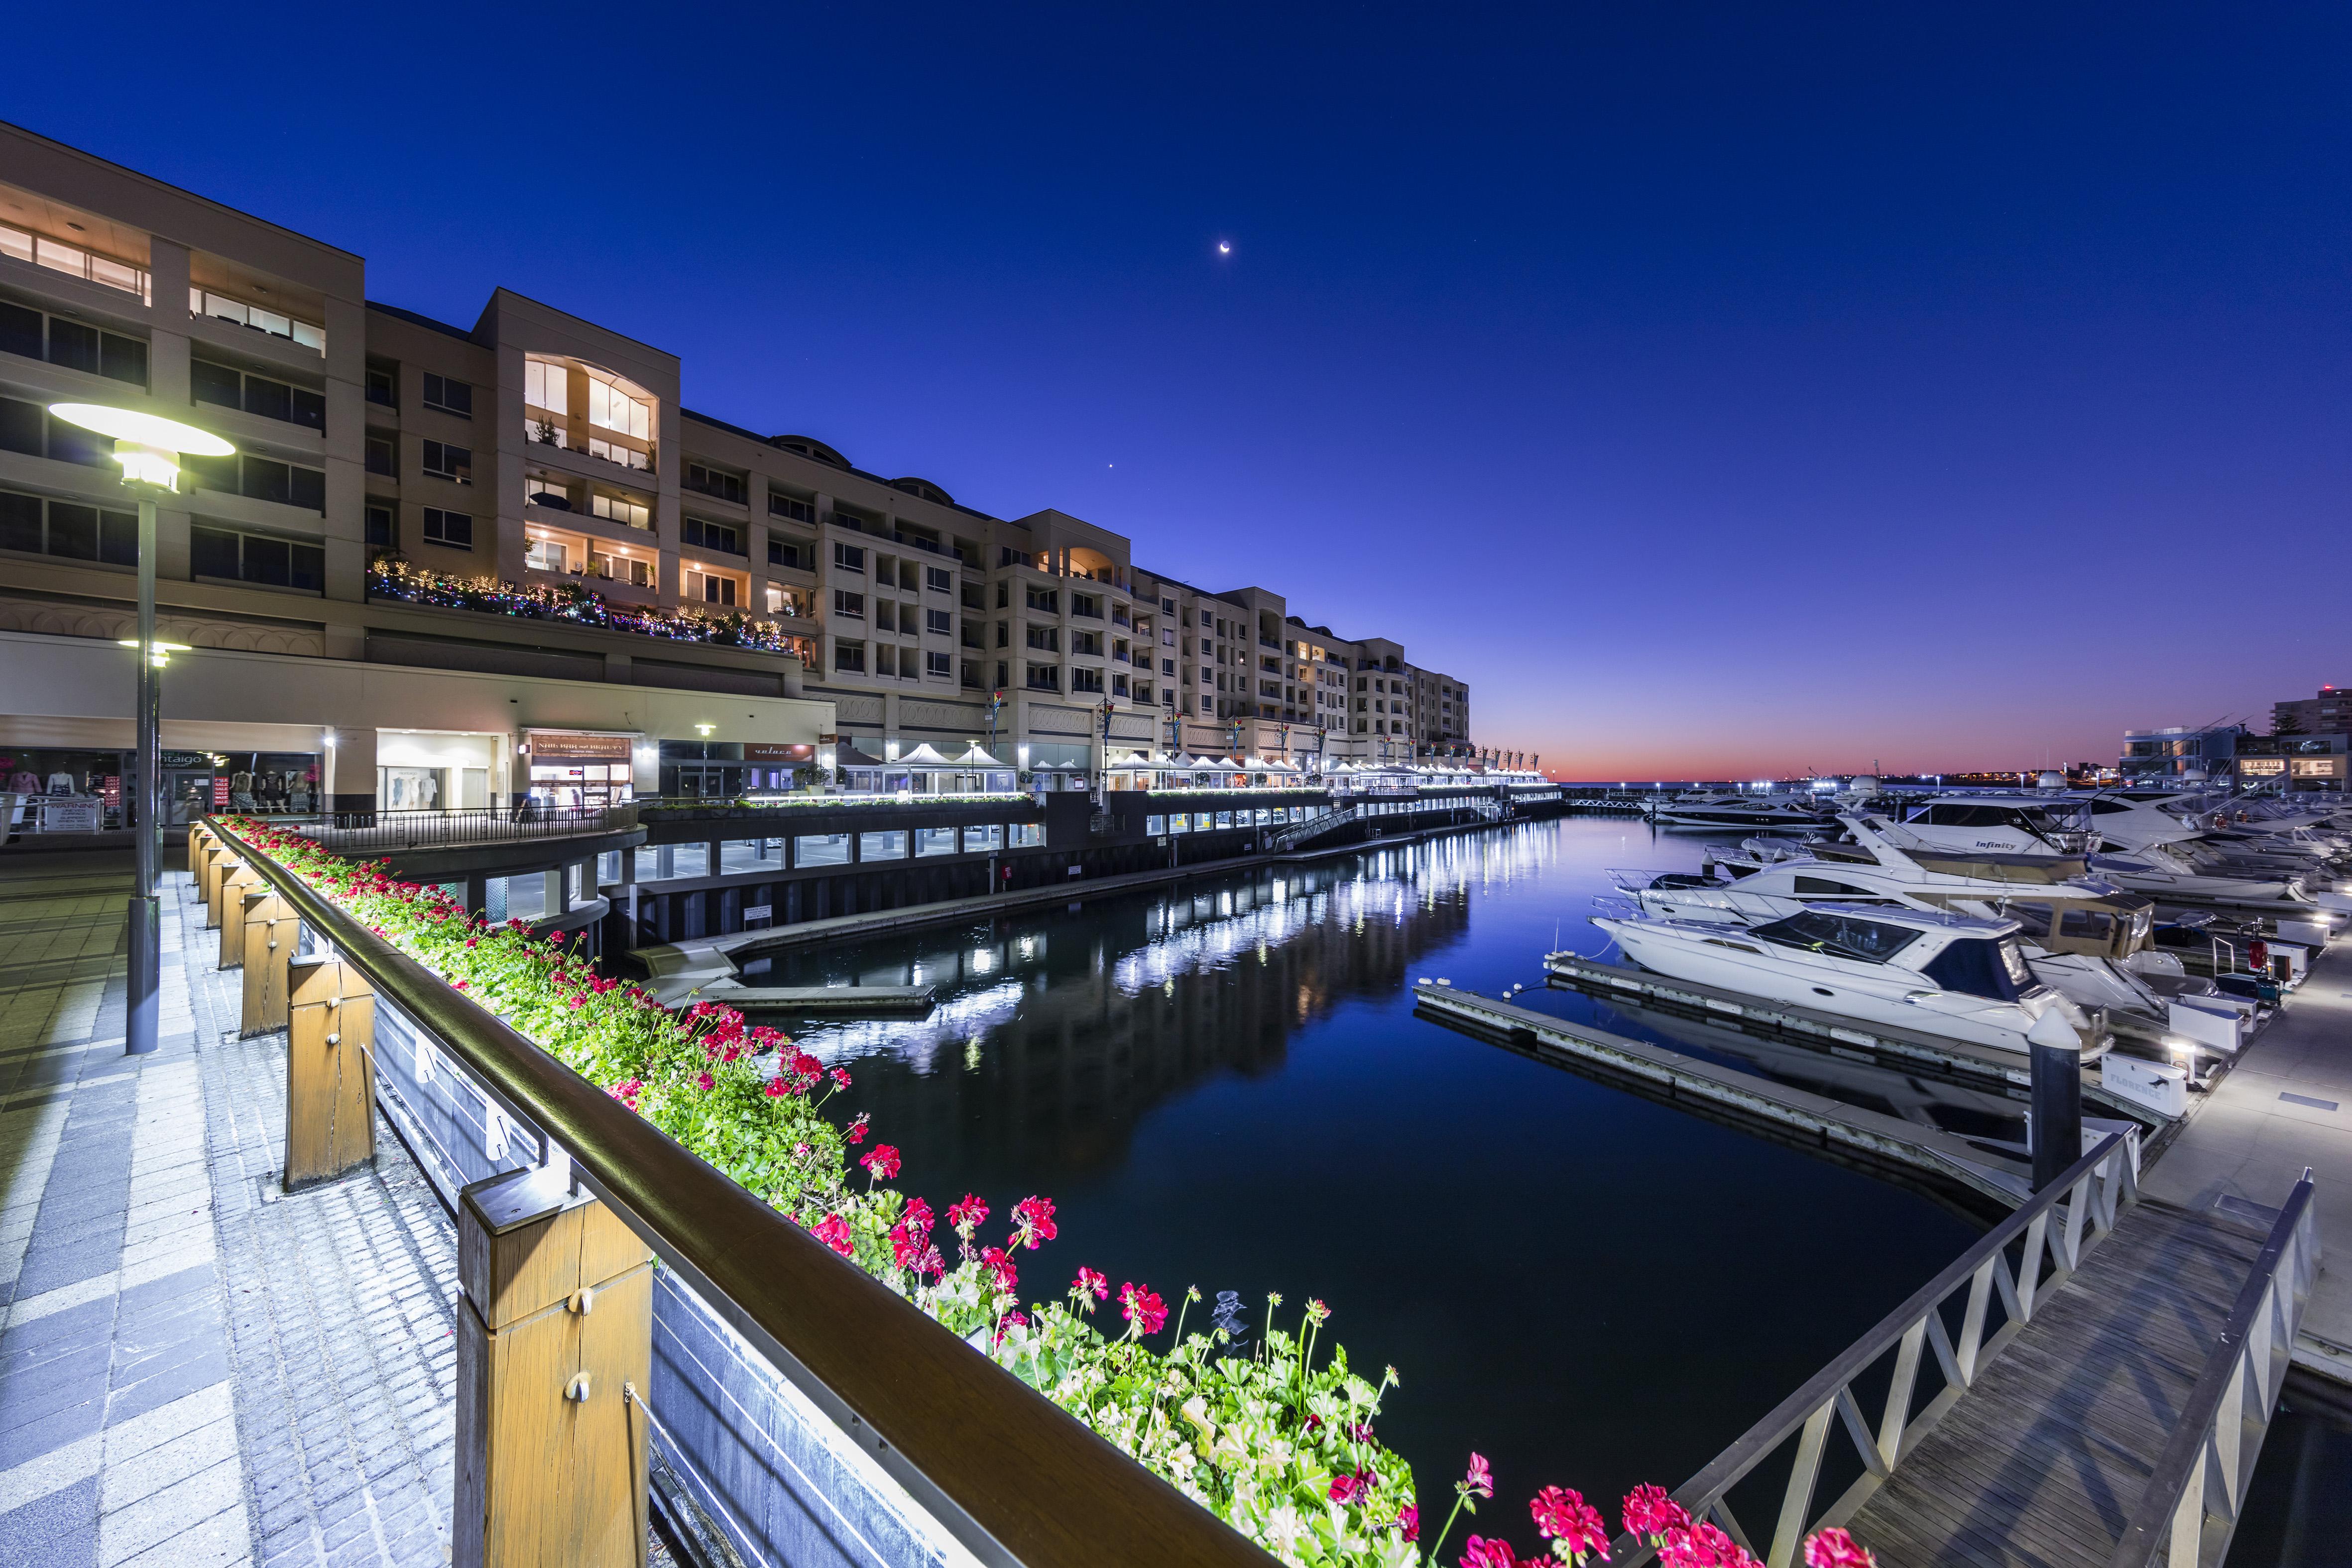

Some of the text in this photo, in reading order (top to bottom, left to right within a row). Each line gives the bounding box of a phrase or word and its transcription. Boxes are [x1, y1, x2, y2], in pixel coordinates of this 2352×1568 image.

[160, 755, 202, 765] ntaigo
[1976, 841, 2016, 850] Infinity
[2111, 1074, 2161, 1101] FLORENCE
